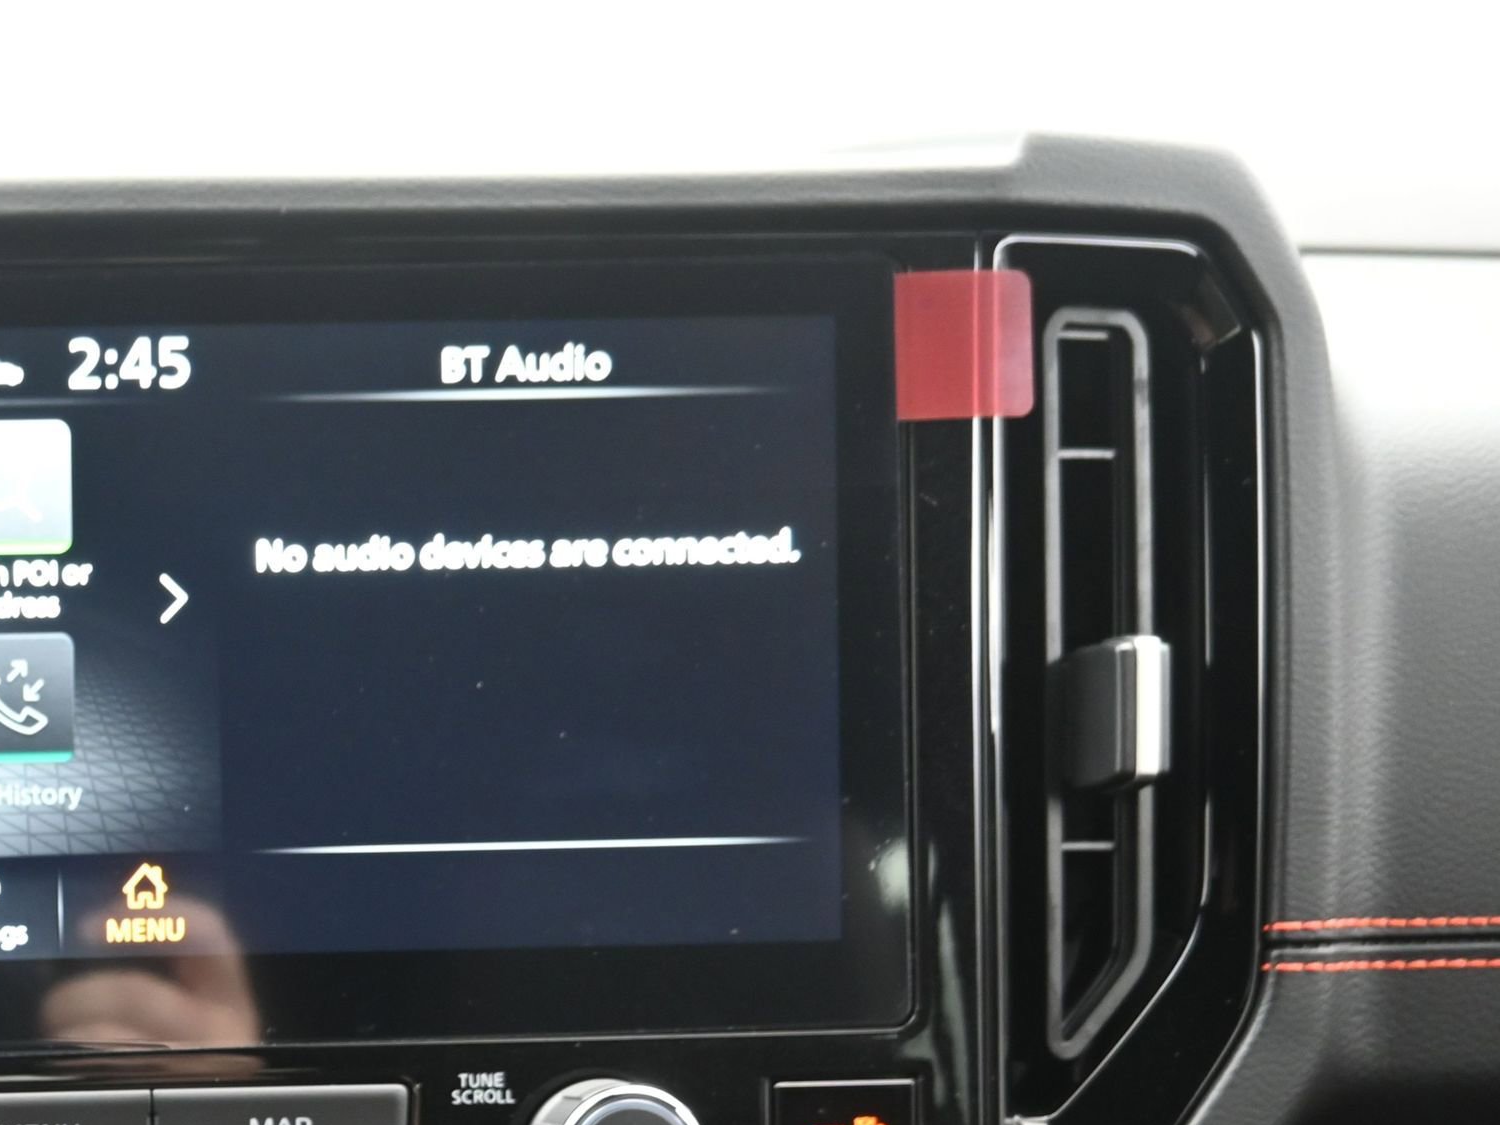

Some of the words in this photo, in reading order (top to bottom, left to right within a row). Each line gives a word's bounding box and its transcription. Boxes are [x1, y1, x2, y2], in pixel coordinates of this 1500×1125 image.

[67, 335, 191, 391] 2:45
[440, 345, 490, 384] BT
[495, 341, 612, 382] Audio
[255, 537, 308, 573] No
[312, 534, 415, 572] audio
[419, 533, 545, 570] devices
[549, 537, 609, 568] are
[612, 526, 801, 567] connected.
[13, 559, 58, 586] POI
[62, 564, 92, 586] or
[105, 917, 186, 943] MENU
[458, 1072, 505, 1089] TUNE
[451, 1088, 515, 1105] SCROLL
